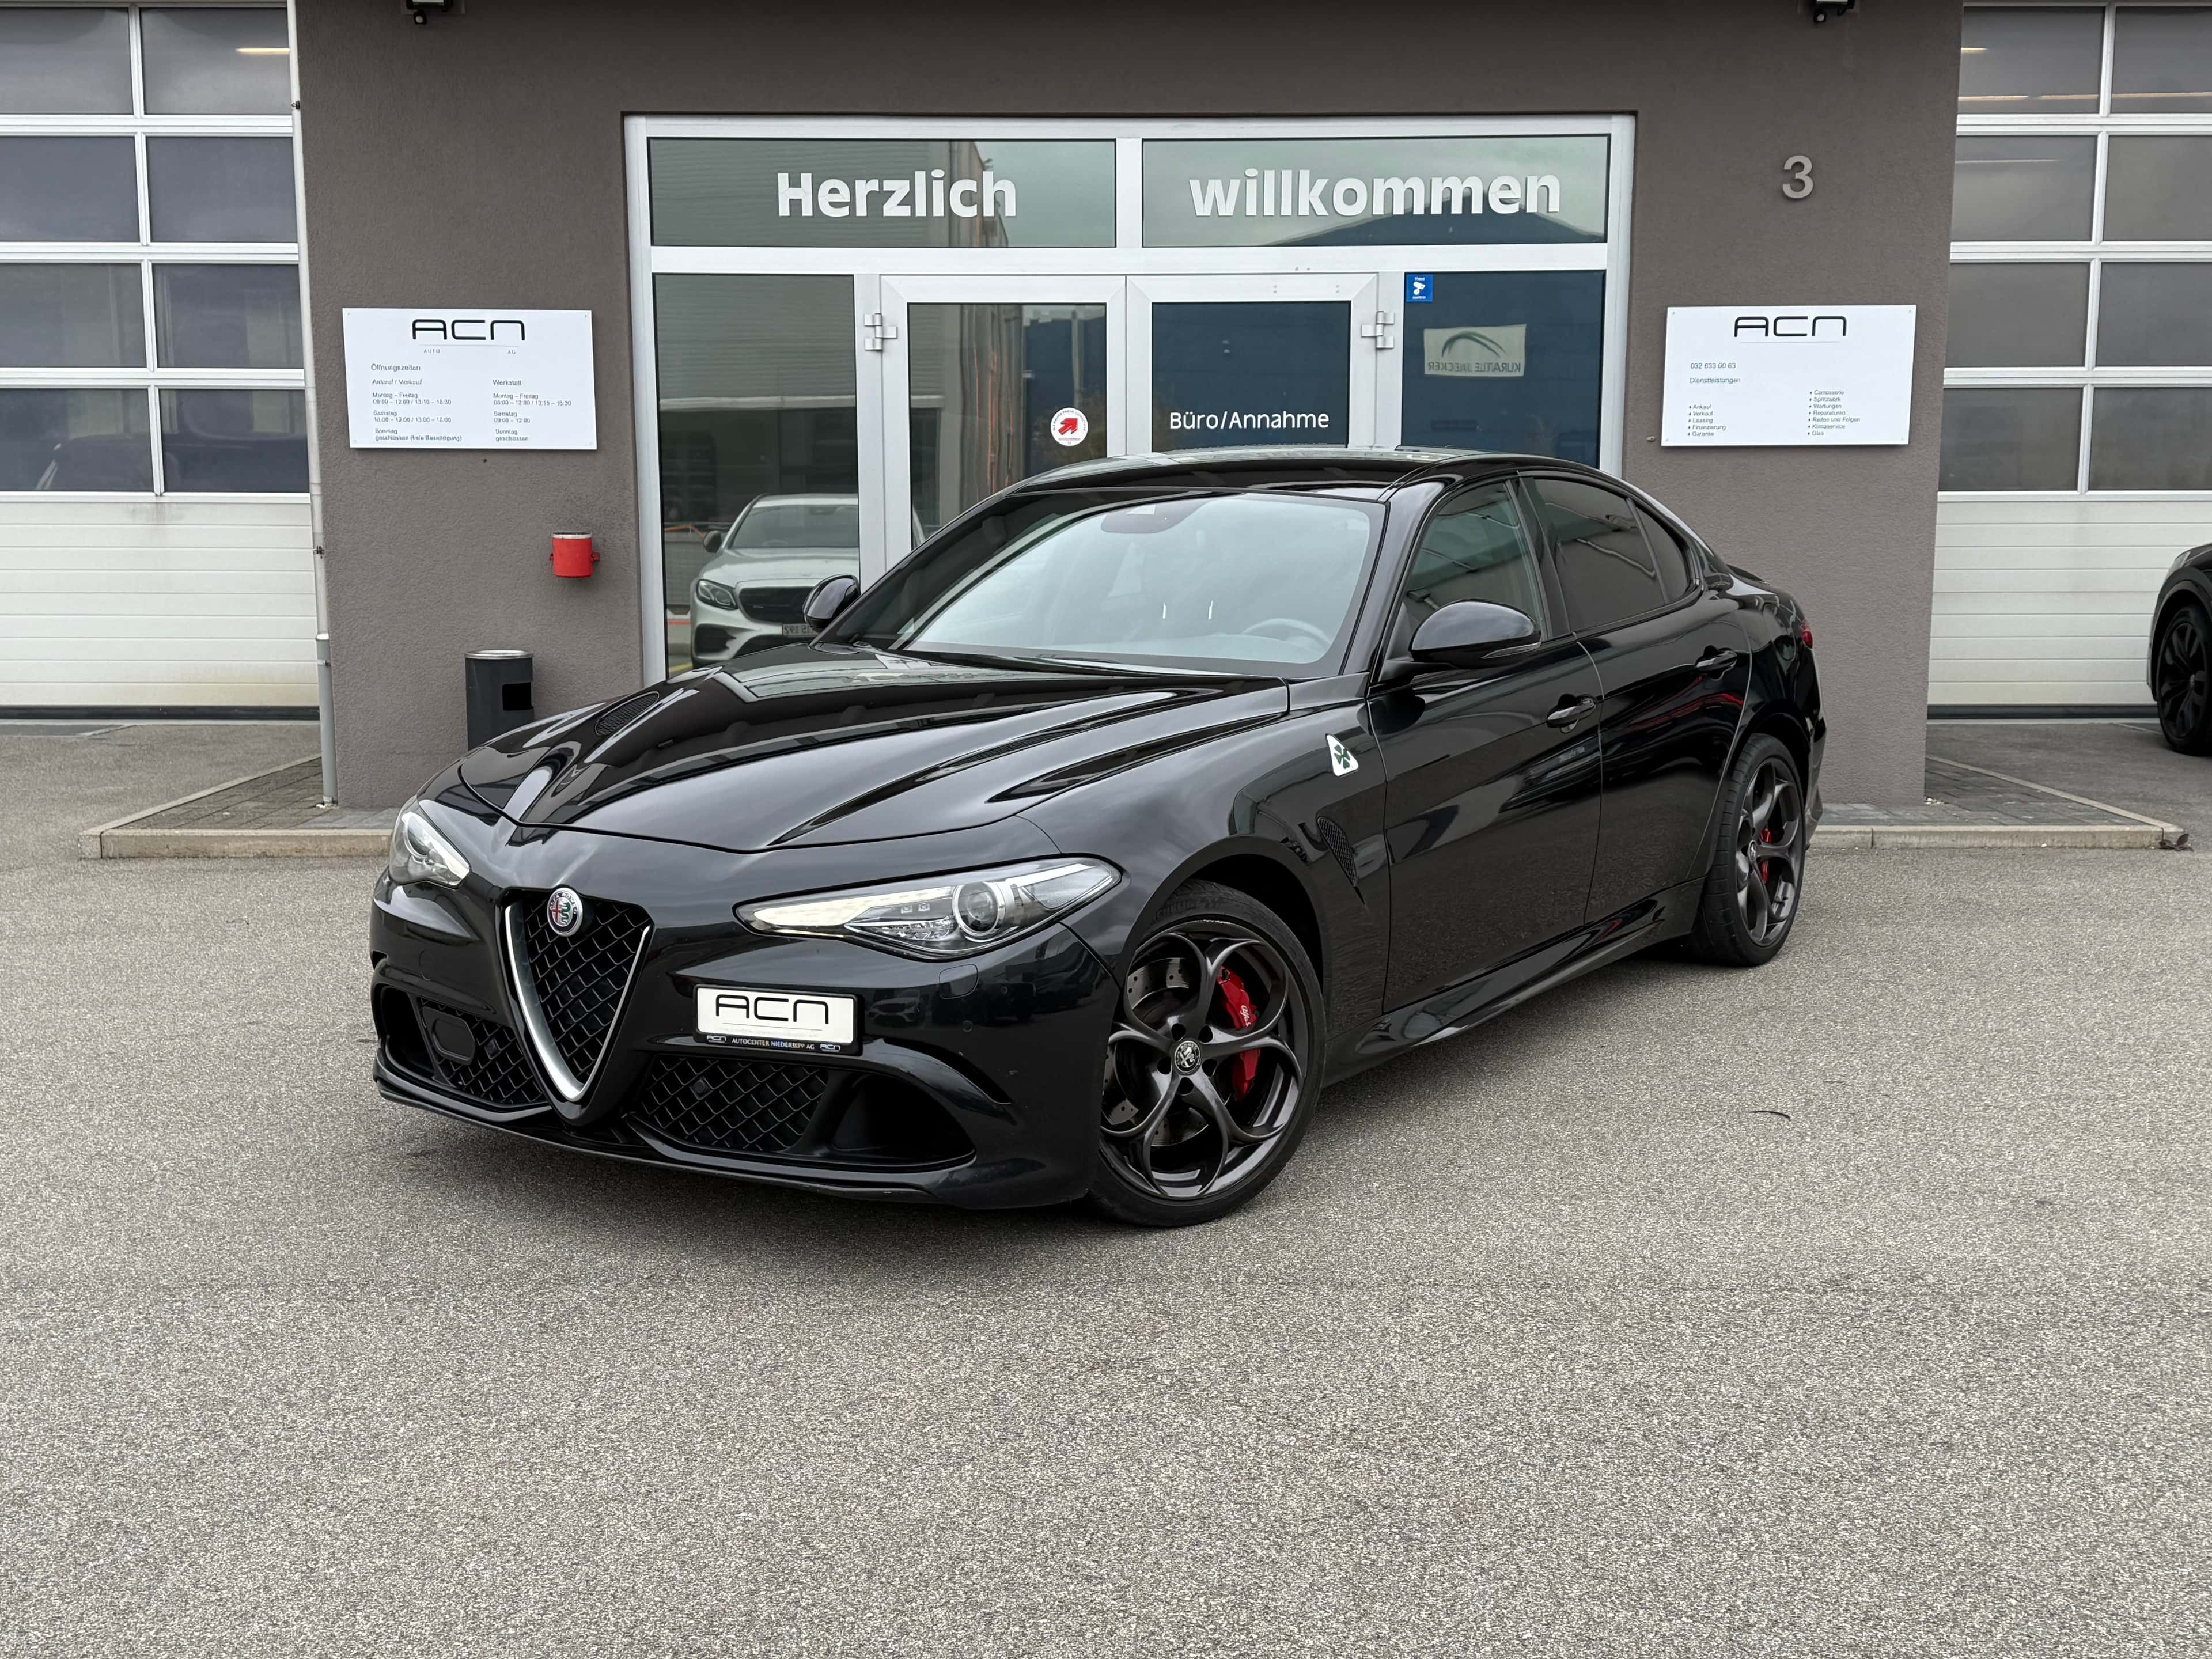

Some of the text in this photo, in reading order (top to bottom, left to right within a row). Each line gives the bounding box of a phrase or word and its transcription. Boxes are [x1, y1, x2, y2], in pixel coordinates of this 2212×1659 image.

[1783, 155, 1813, 198] 3
[778, 168, 1560, 217] Herzlich willkommen
[370, 363, 421, 372] Öffnungszeiten
[1169, 411, 1330, 429] Büro/Annahme
[732, 1037, 770, 1046] AUTOCENTER
